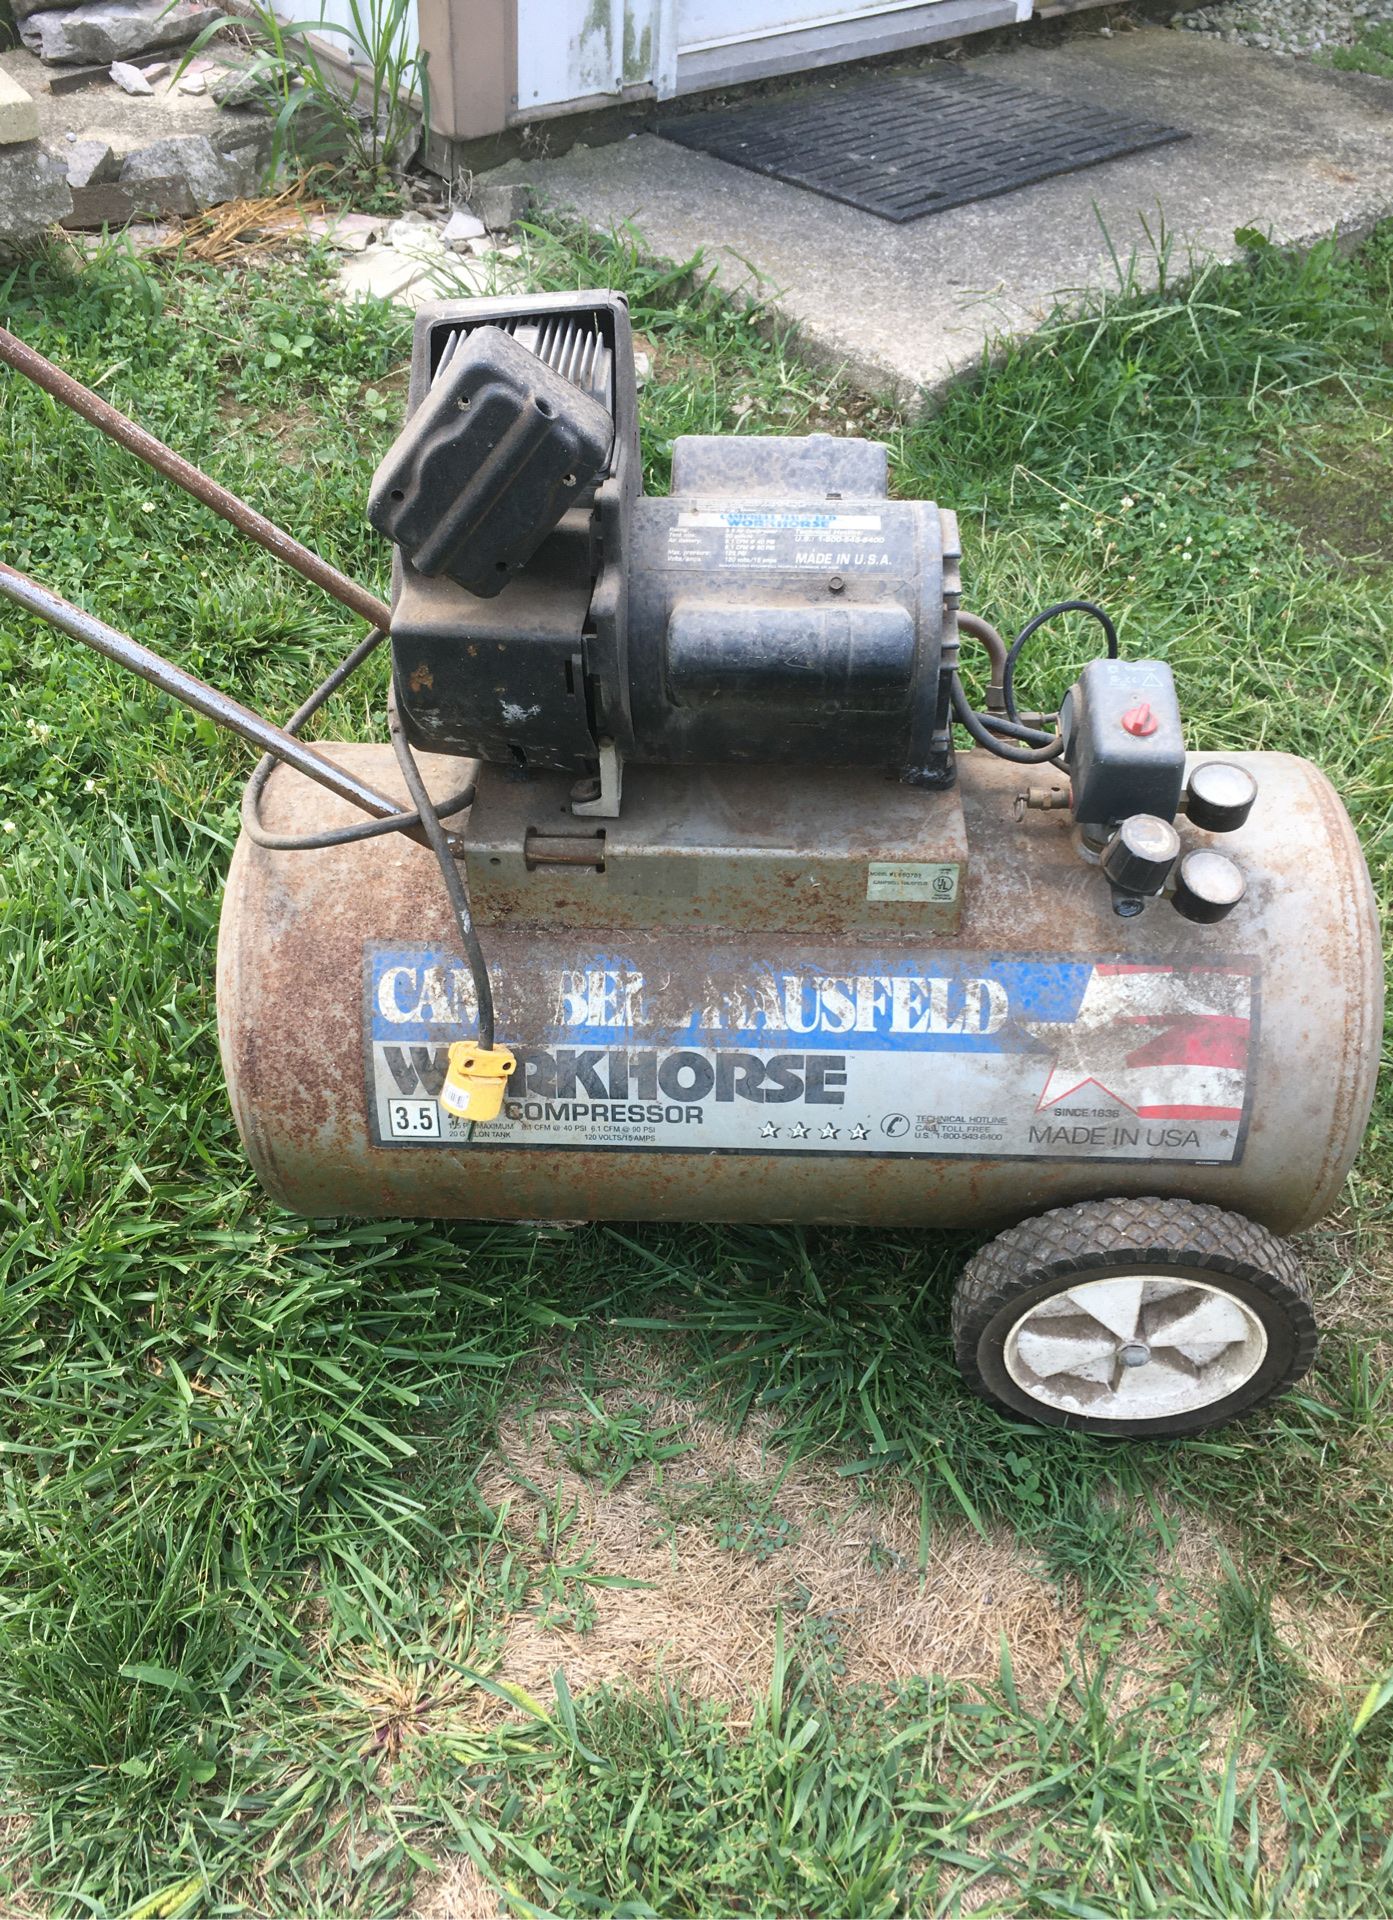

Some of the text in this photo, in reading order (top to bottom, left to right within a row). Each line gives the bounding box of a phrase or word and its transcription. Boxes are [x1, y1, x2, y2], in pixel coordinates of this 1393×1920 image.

[728, 519, 830, 528] WORKHORSE
[796, 552, 892, 565] MADE IN U.S.A.
[382, 1045, 848, 1105] WRKHORSE
[395, 1106, 433, 1131] 3.5
[504, 1101, 704, 1124] COMPRESSOR
[1054, 1107, 1090, 1117] SINCE
[916, 1115, 1008, 1124] TECHNICAL HOTLINE
[942, 1125, 964, 1133] TOLL
[1028, 1125, 1201, 1148] MADE IN USA
